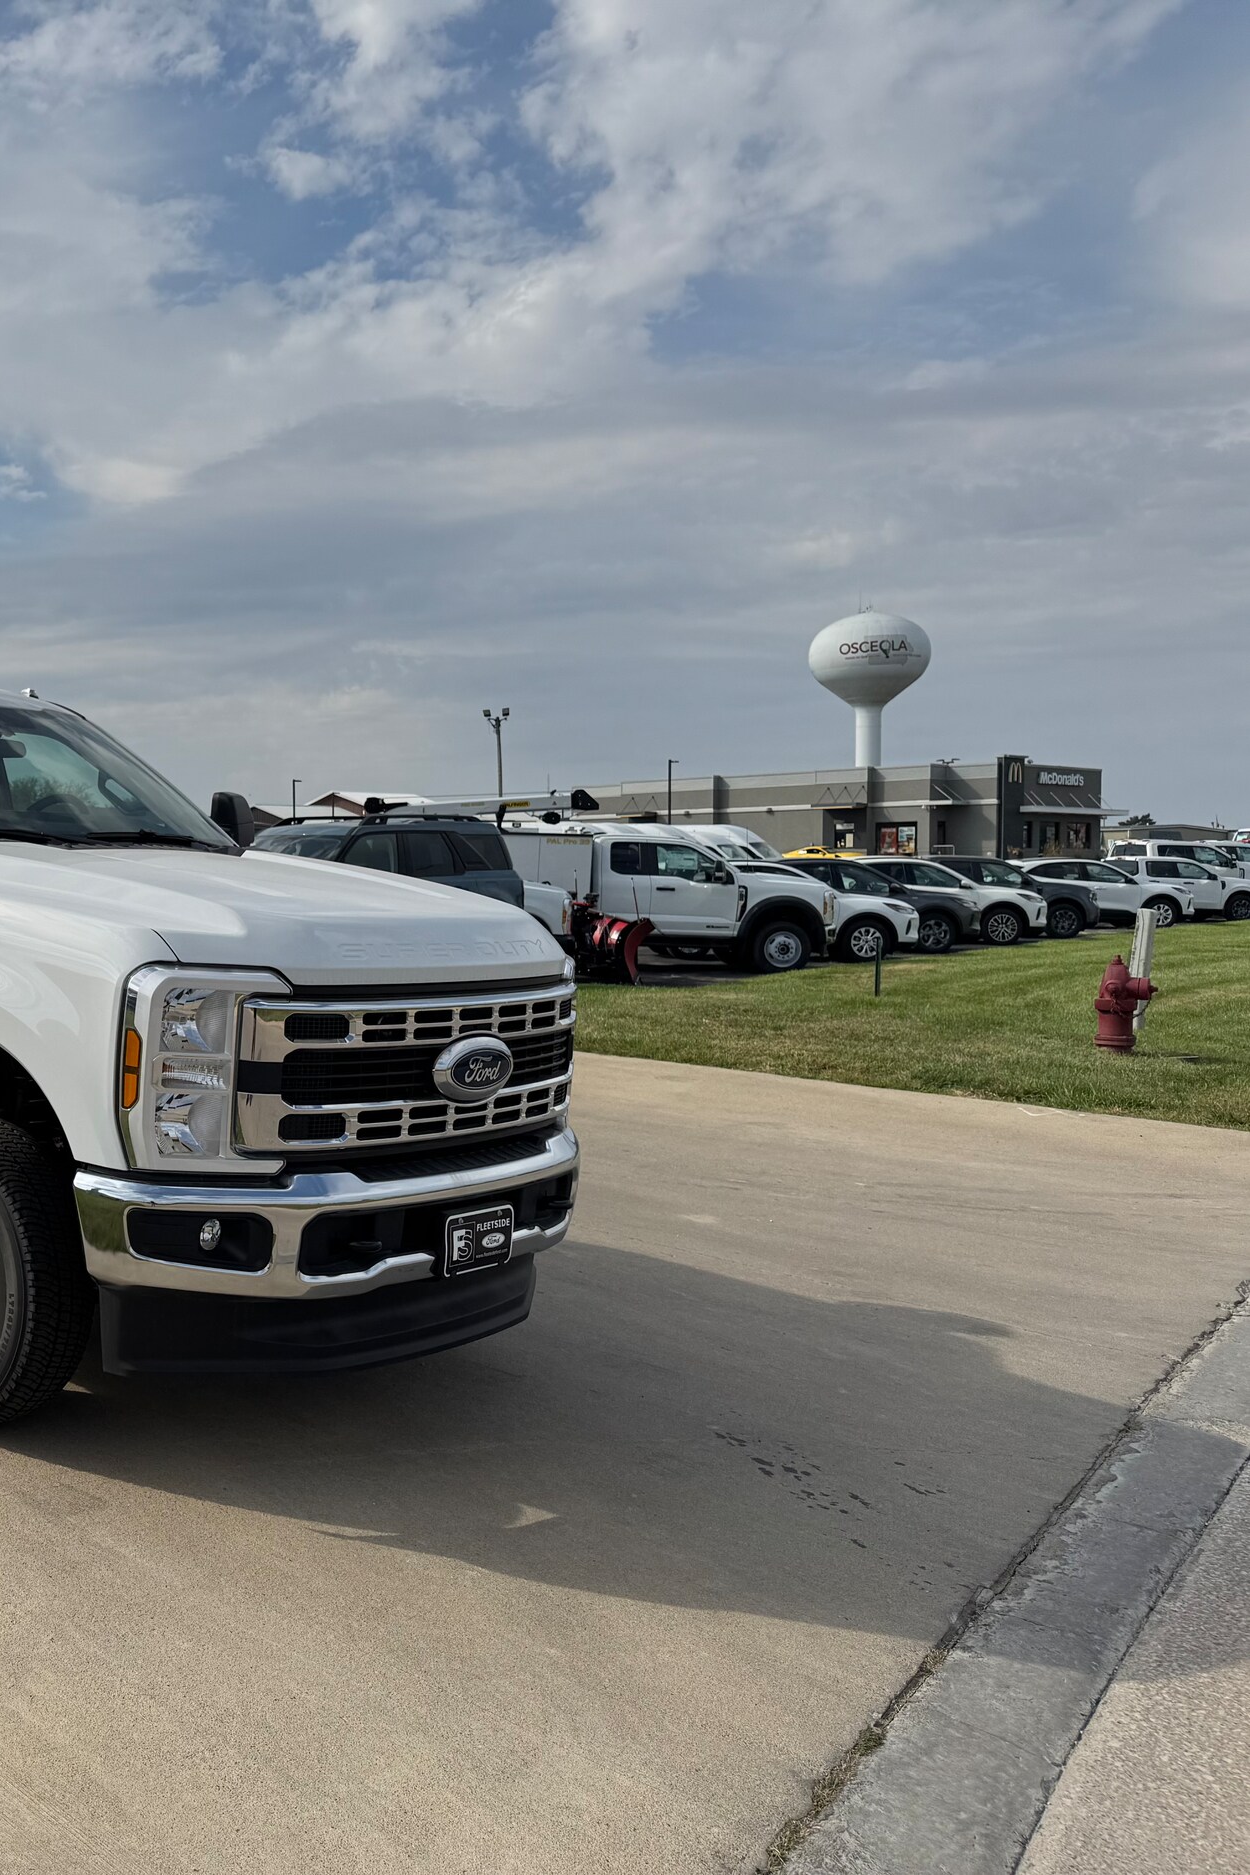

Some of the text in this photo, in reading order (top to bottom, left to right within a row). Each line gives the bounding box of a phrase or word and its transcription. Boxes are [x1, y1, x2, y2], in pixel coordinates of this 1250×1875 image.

[839, 640, 907, 655] OSCEOLA
[1039, 772, 1084, 786] McDonald's
[546, 836, 561, 845] PAL
[563, 836, 577, 845] Pro
[338, 938, 544, 961] SUPER DUTY
[464, 1055, 501, 1083] Ford
[476, 1218, 511, 1232] FLEETSIDE
[485, 1235, 501, 1245] Ford
